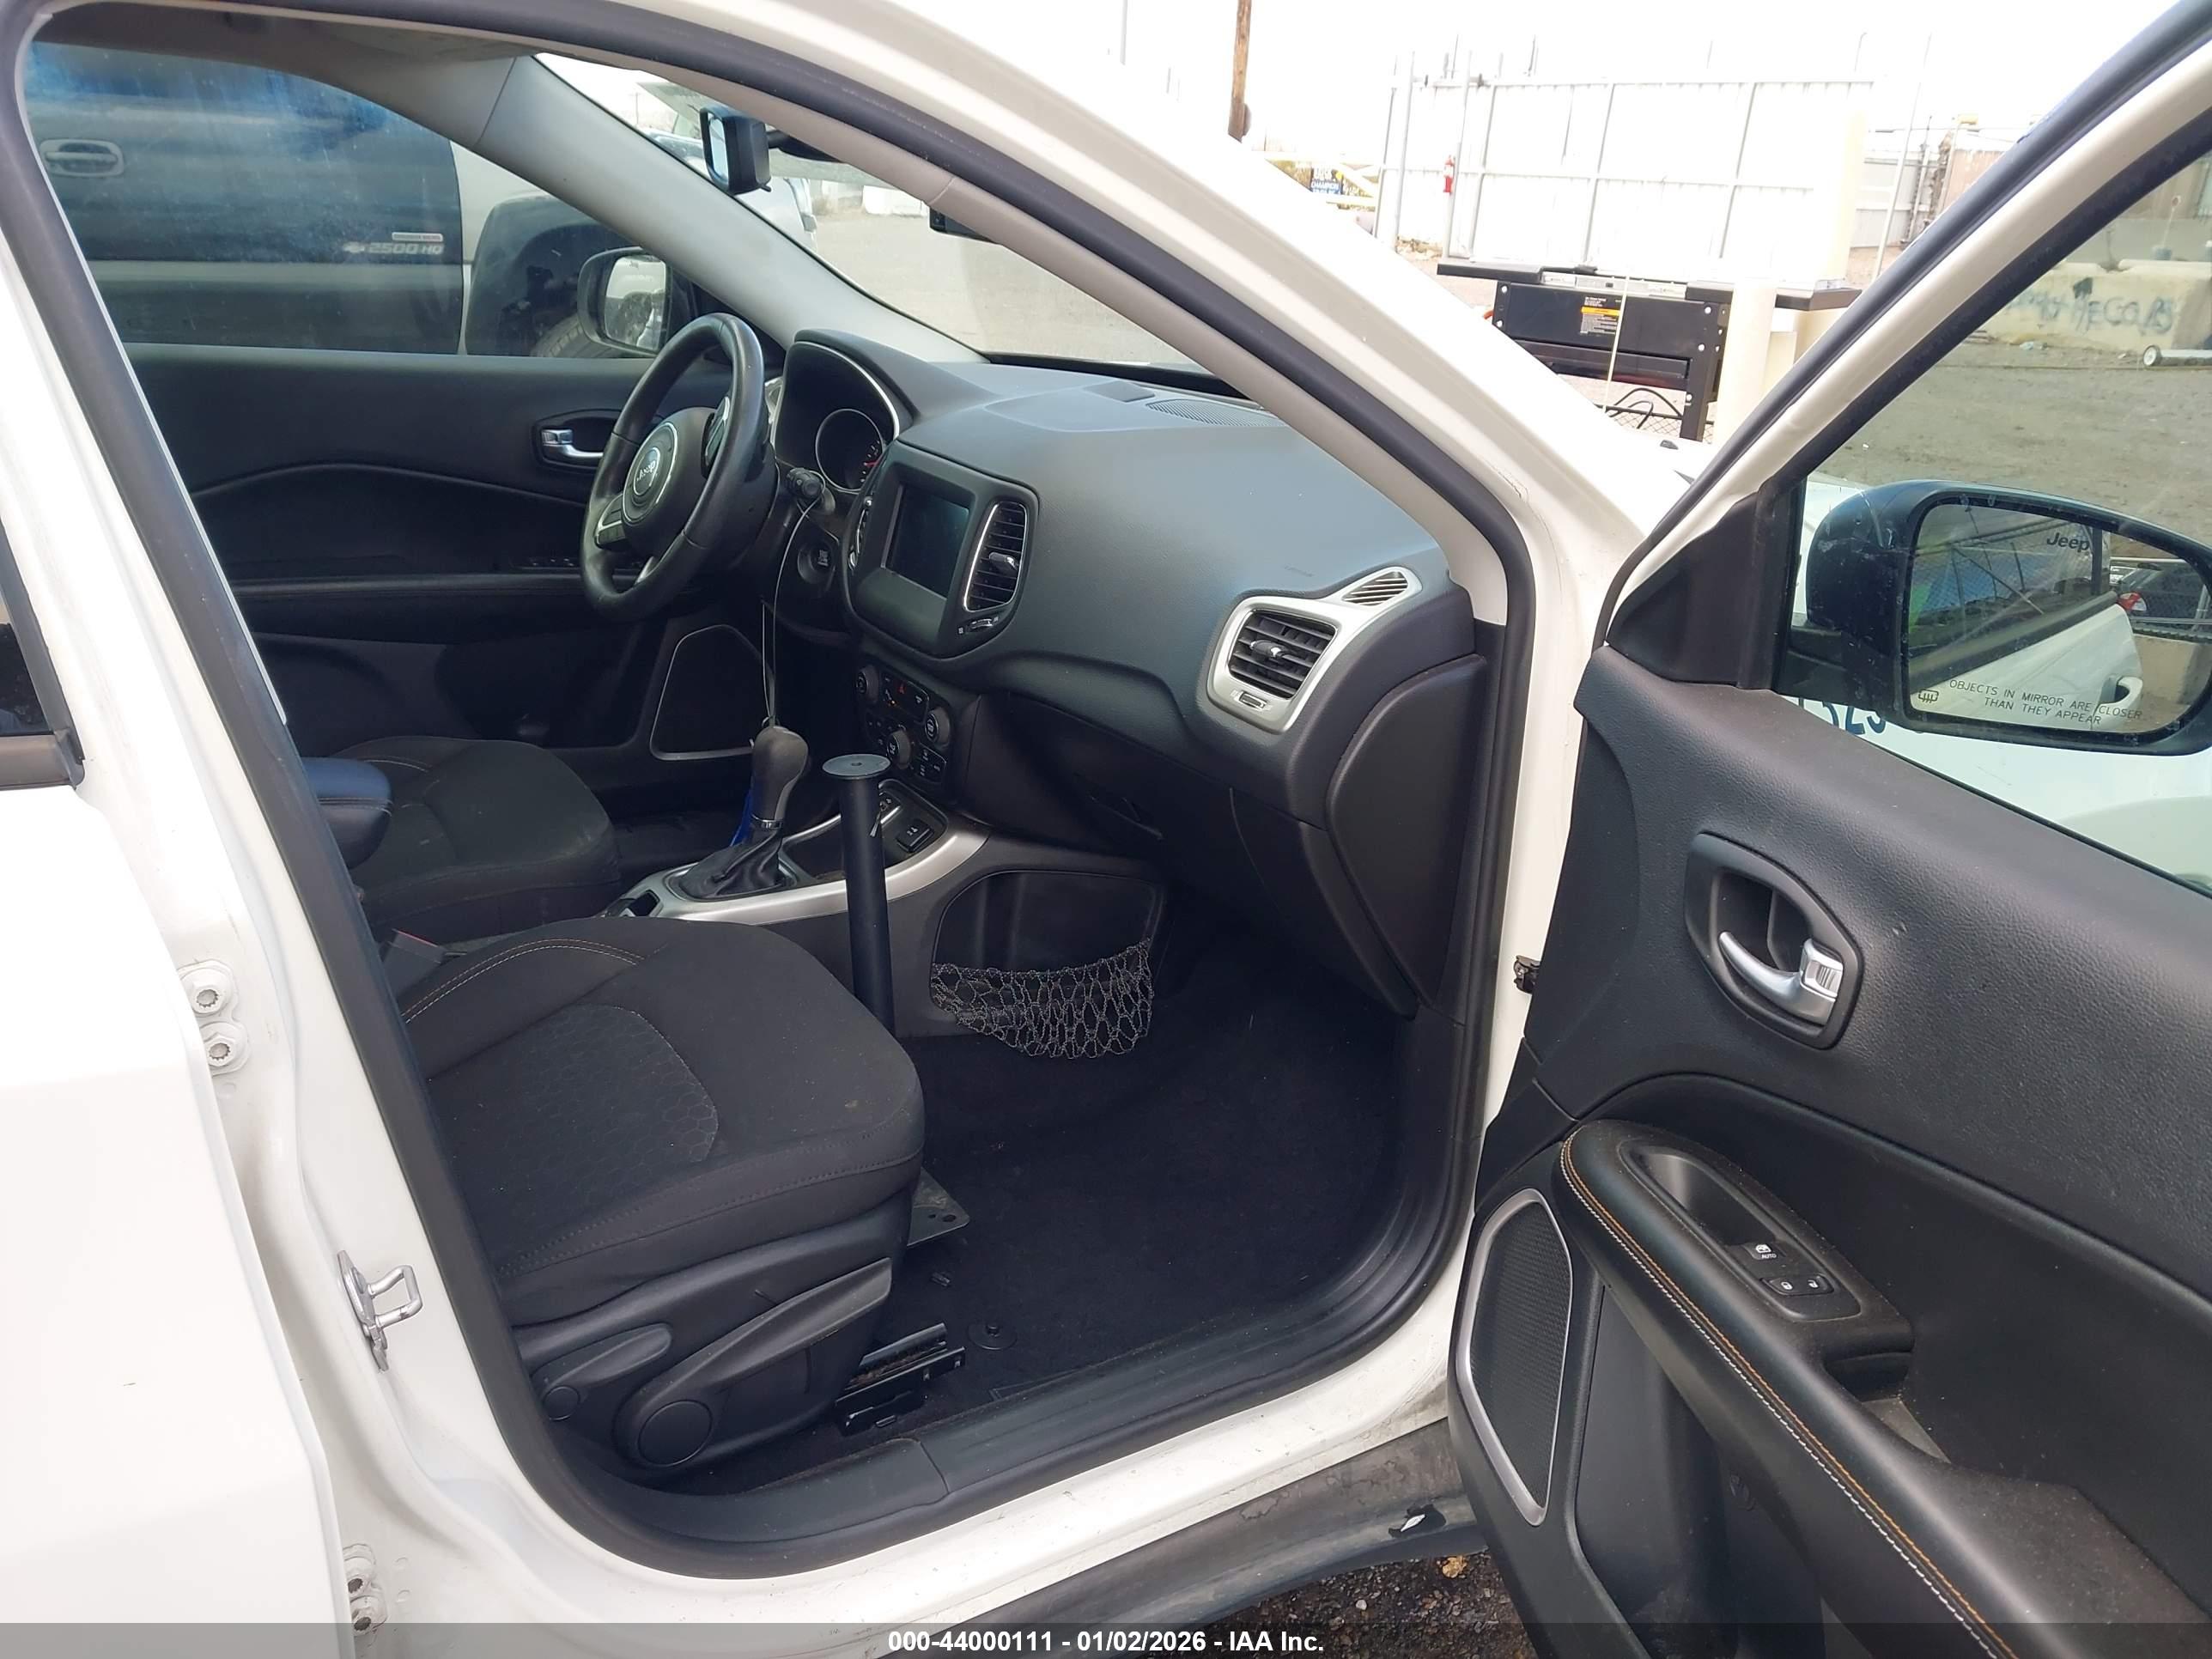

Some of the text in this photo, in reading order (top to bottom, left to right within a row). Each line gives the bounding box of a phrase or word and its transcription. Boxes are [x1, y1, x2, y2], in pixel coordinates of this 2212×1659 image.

[2046, 532, 2091, 553] Jeep
[1949, 679, 2142, 720] OBJECTS IN MIRROR ARE CLOSER
[1984, 697, 2102, 725] THAN THEY APPEAR
